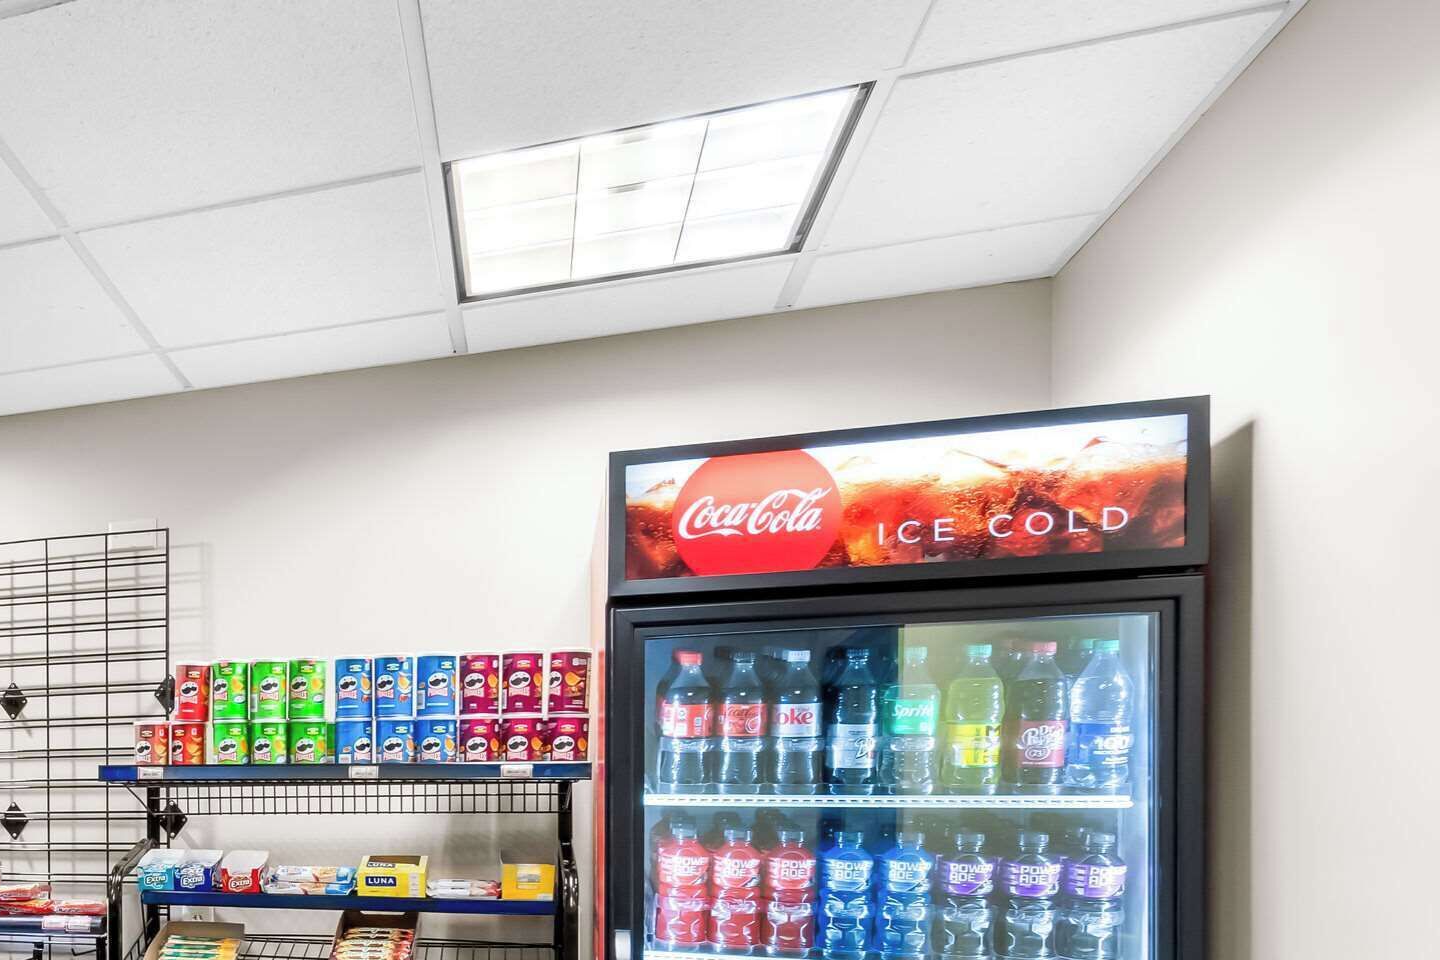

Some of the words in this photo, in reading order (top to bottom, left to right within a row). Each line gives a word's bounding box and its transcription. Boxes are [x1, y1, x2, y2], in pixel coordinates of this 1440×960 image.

[678, 487, 832, 540] Coca-Cola
[878, 518, 955, 545] ICE
[988, 507, 1129, 538] COLD
[776, 707, 813, 724] oke
[367, 876, 395, 886] LUNA
